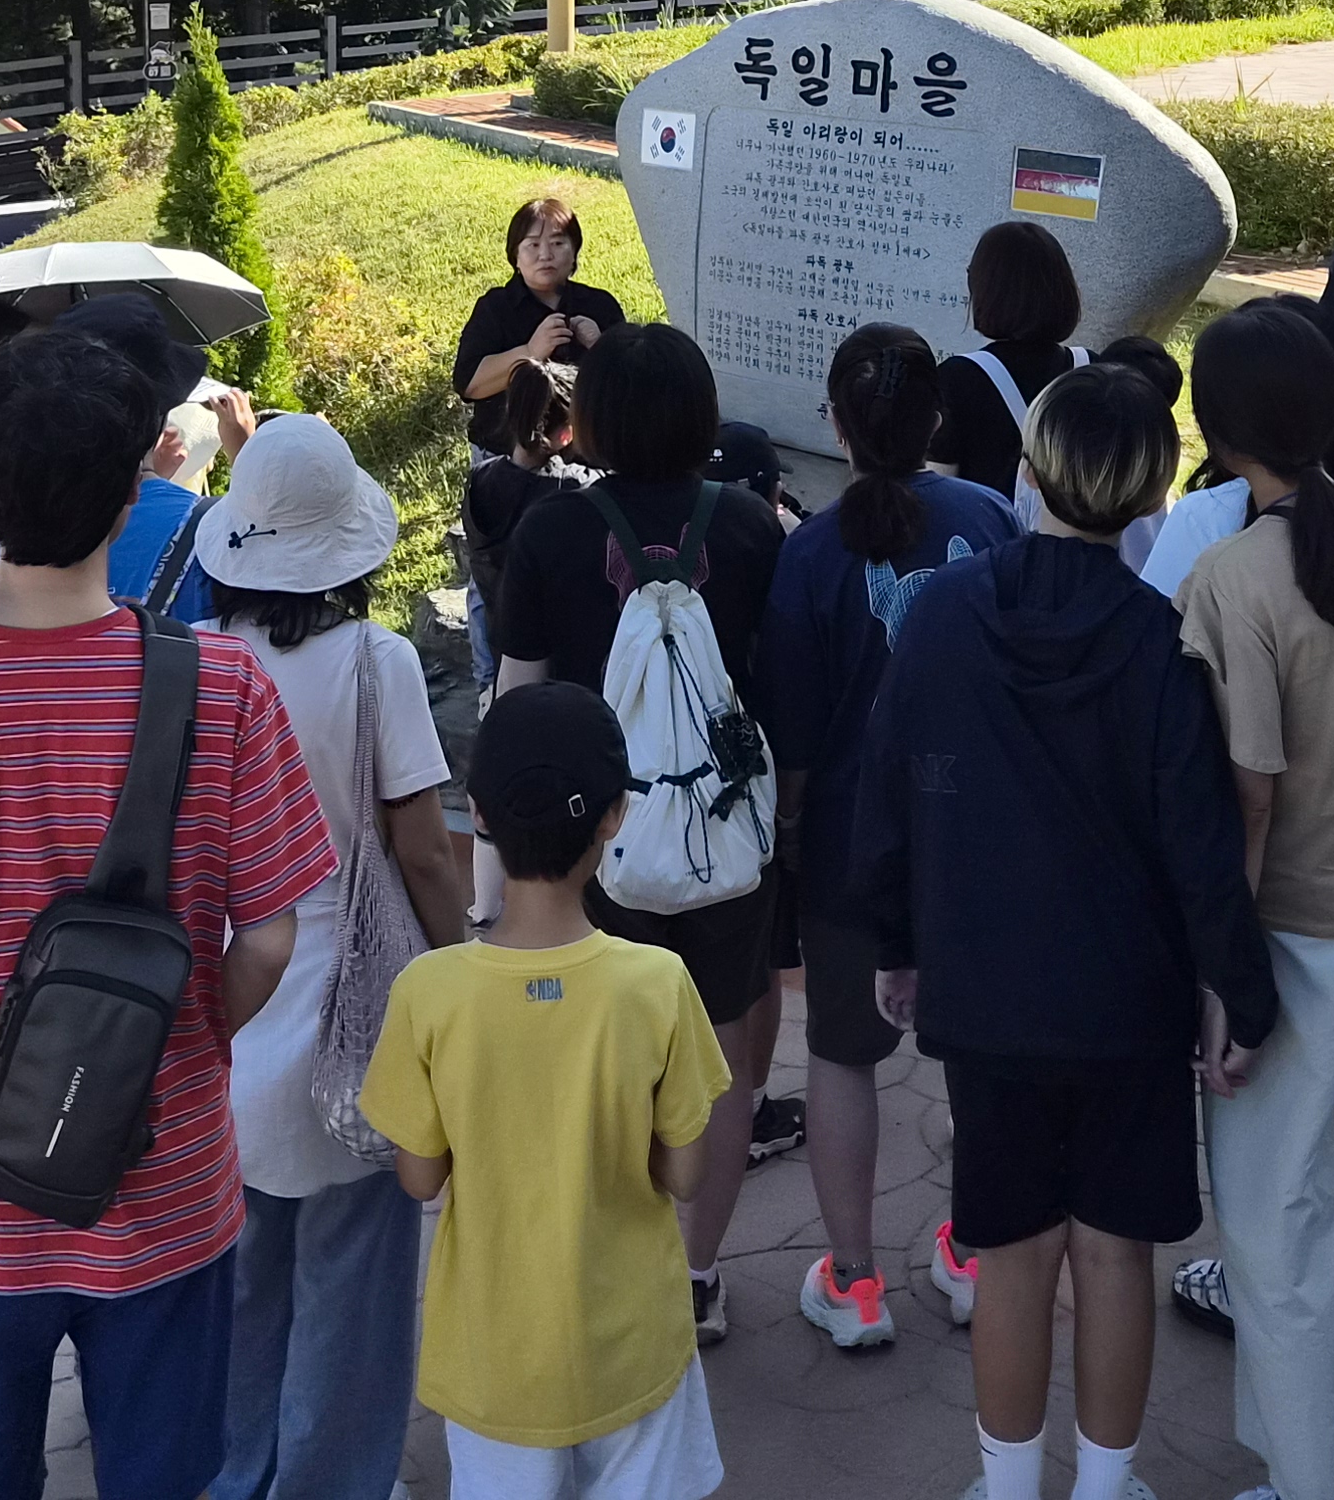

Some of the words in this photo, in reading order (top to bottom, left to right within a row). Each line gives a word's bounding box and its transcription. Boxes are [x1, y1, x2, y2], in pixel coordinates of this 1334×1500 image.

[734, 37, 967, 117] 독일마을
[766, 118, 794, 138] 독일
[803, 122, 863, 147] 아리랑이
[736, 139, 763, 151] 너무나
[767, 142, 805, 158] 가난했던
[809, 147, 897, 169] 1960-1970년도
[904, 157, 955, 175] 우리나라!
[745, 171, 763, 184] 파독
[767, 174, 796, 189] 광부와
[802, 178, 840, 194] 간호사로
[819, 166, 838, 178] 위해
[881, 172, 914, 188] 독일로
[721, 184, 746, 197] 조국의
[752, 187, 798, 205] 경제발전에
[854, 202, 895, 219] 당신들의
[802, 211, 850, 229] 대한민국의
[857, 219, 909, 237] 역사입니다
[789, 228, 807, 242] 파독
[812, 232, 830, 246] 광부
[836, 236, 865, 251] 간호사
[806, 254, 827, 270] 파독
[832, 258, 855, 274] 광부
[797, 307, 819, 322] 파독
[824, 312, 857, 329] 간호사
[537, 977, 563, 1000] NBA
[61, 1066, 85, 1112] FASHION
